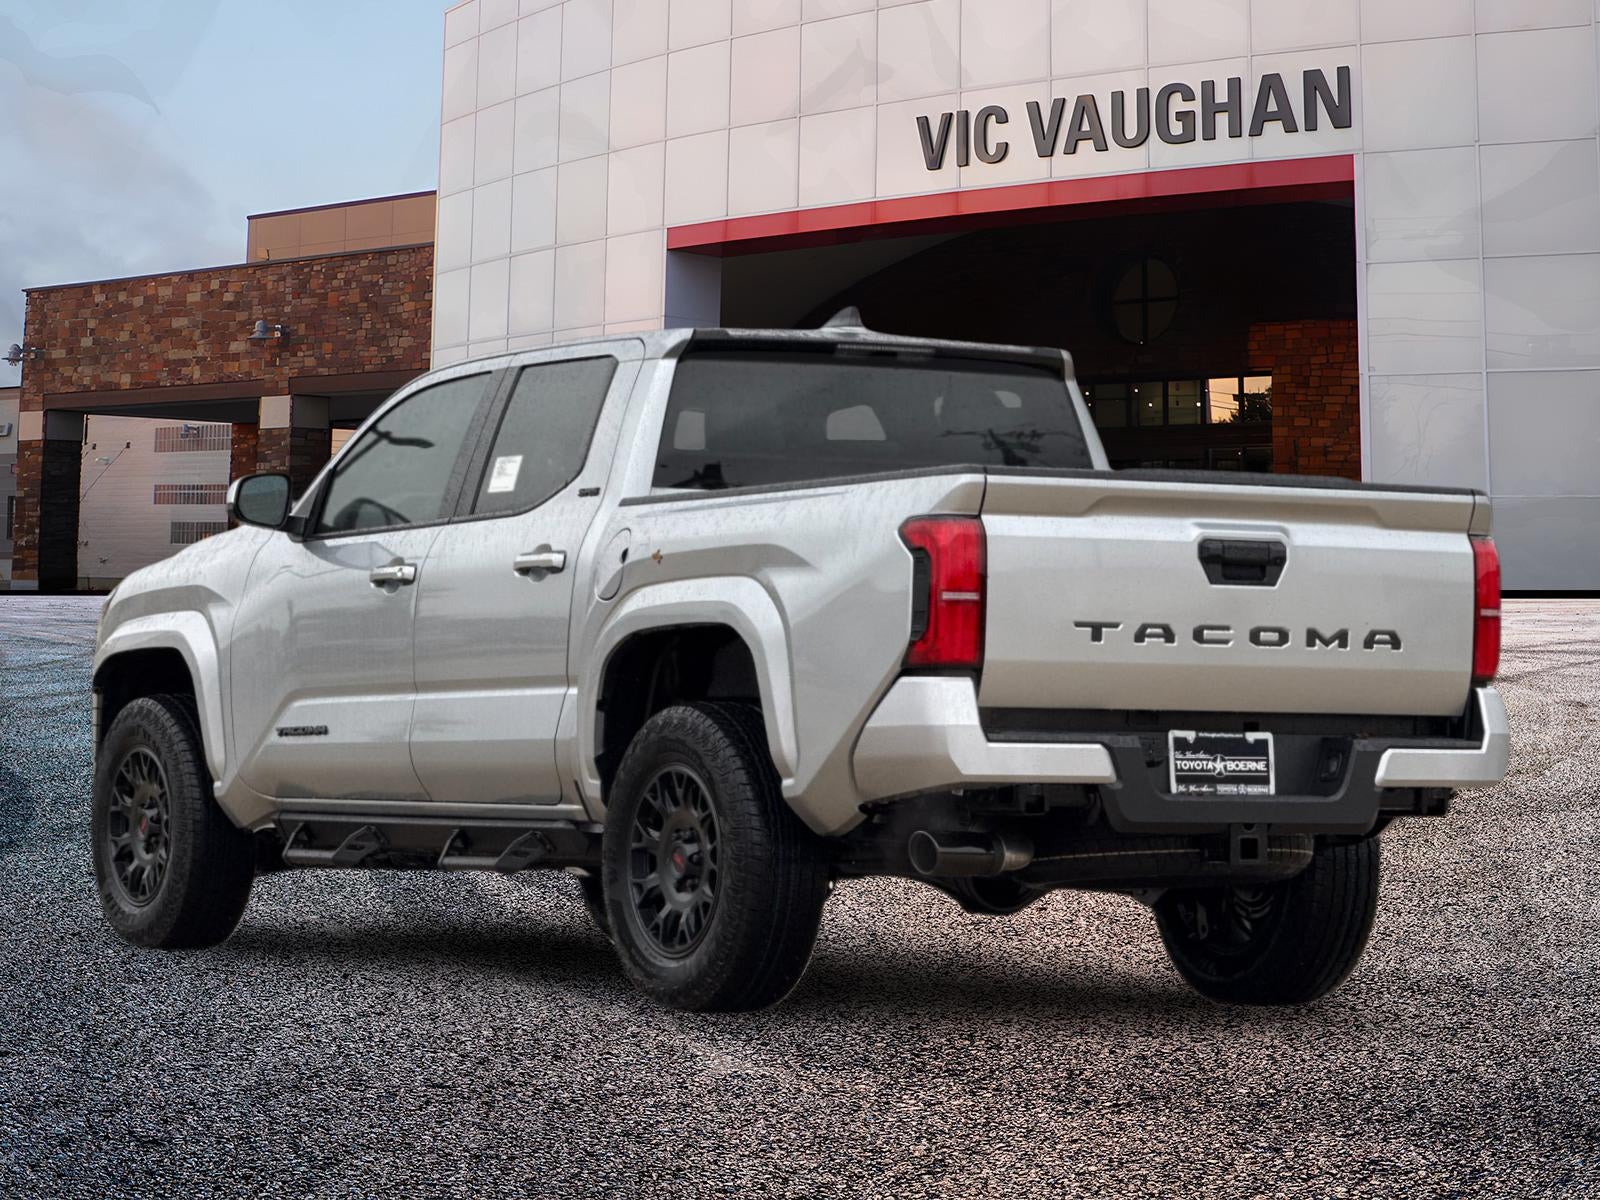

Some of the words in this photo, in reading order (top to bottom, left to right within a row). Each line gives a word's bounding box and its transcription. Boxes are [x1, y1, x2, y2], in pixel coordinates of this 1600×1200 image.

[916, 105, 1009, 171] VIC
[1026, 65, 1352, 158] VAUGHAN
[1073, 621, 1403, 651] TACOMA
[1175, 760, 1213, 770] TOYOTA
[1227, 761, 1267, 771] BOERNE
